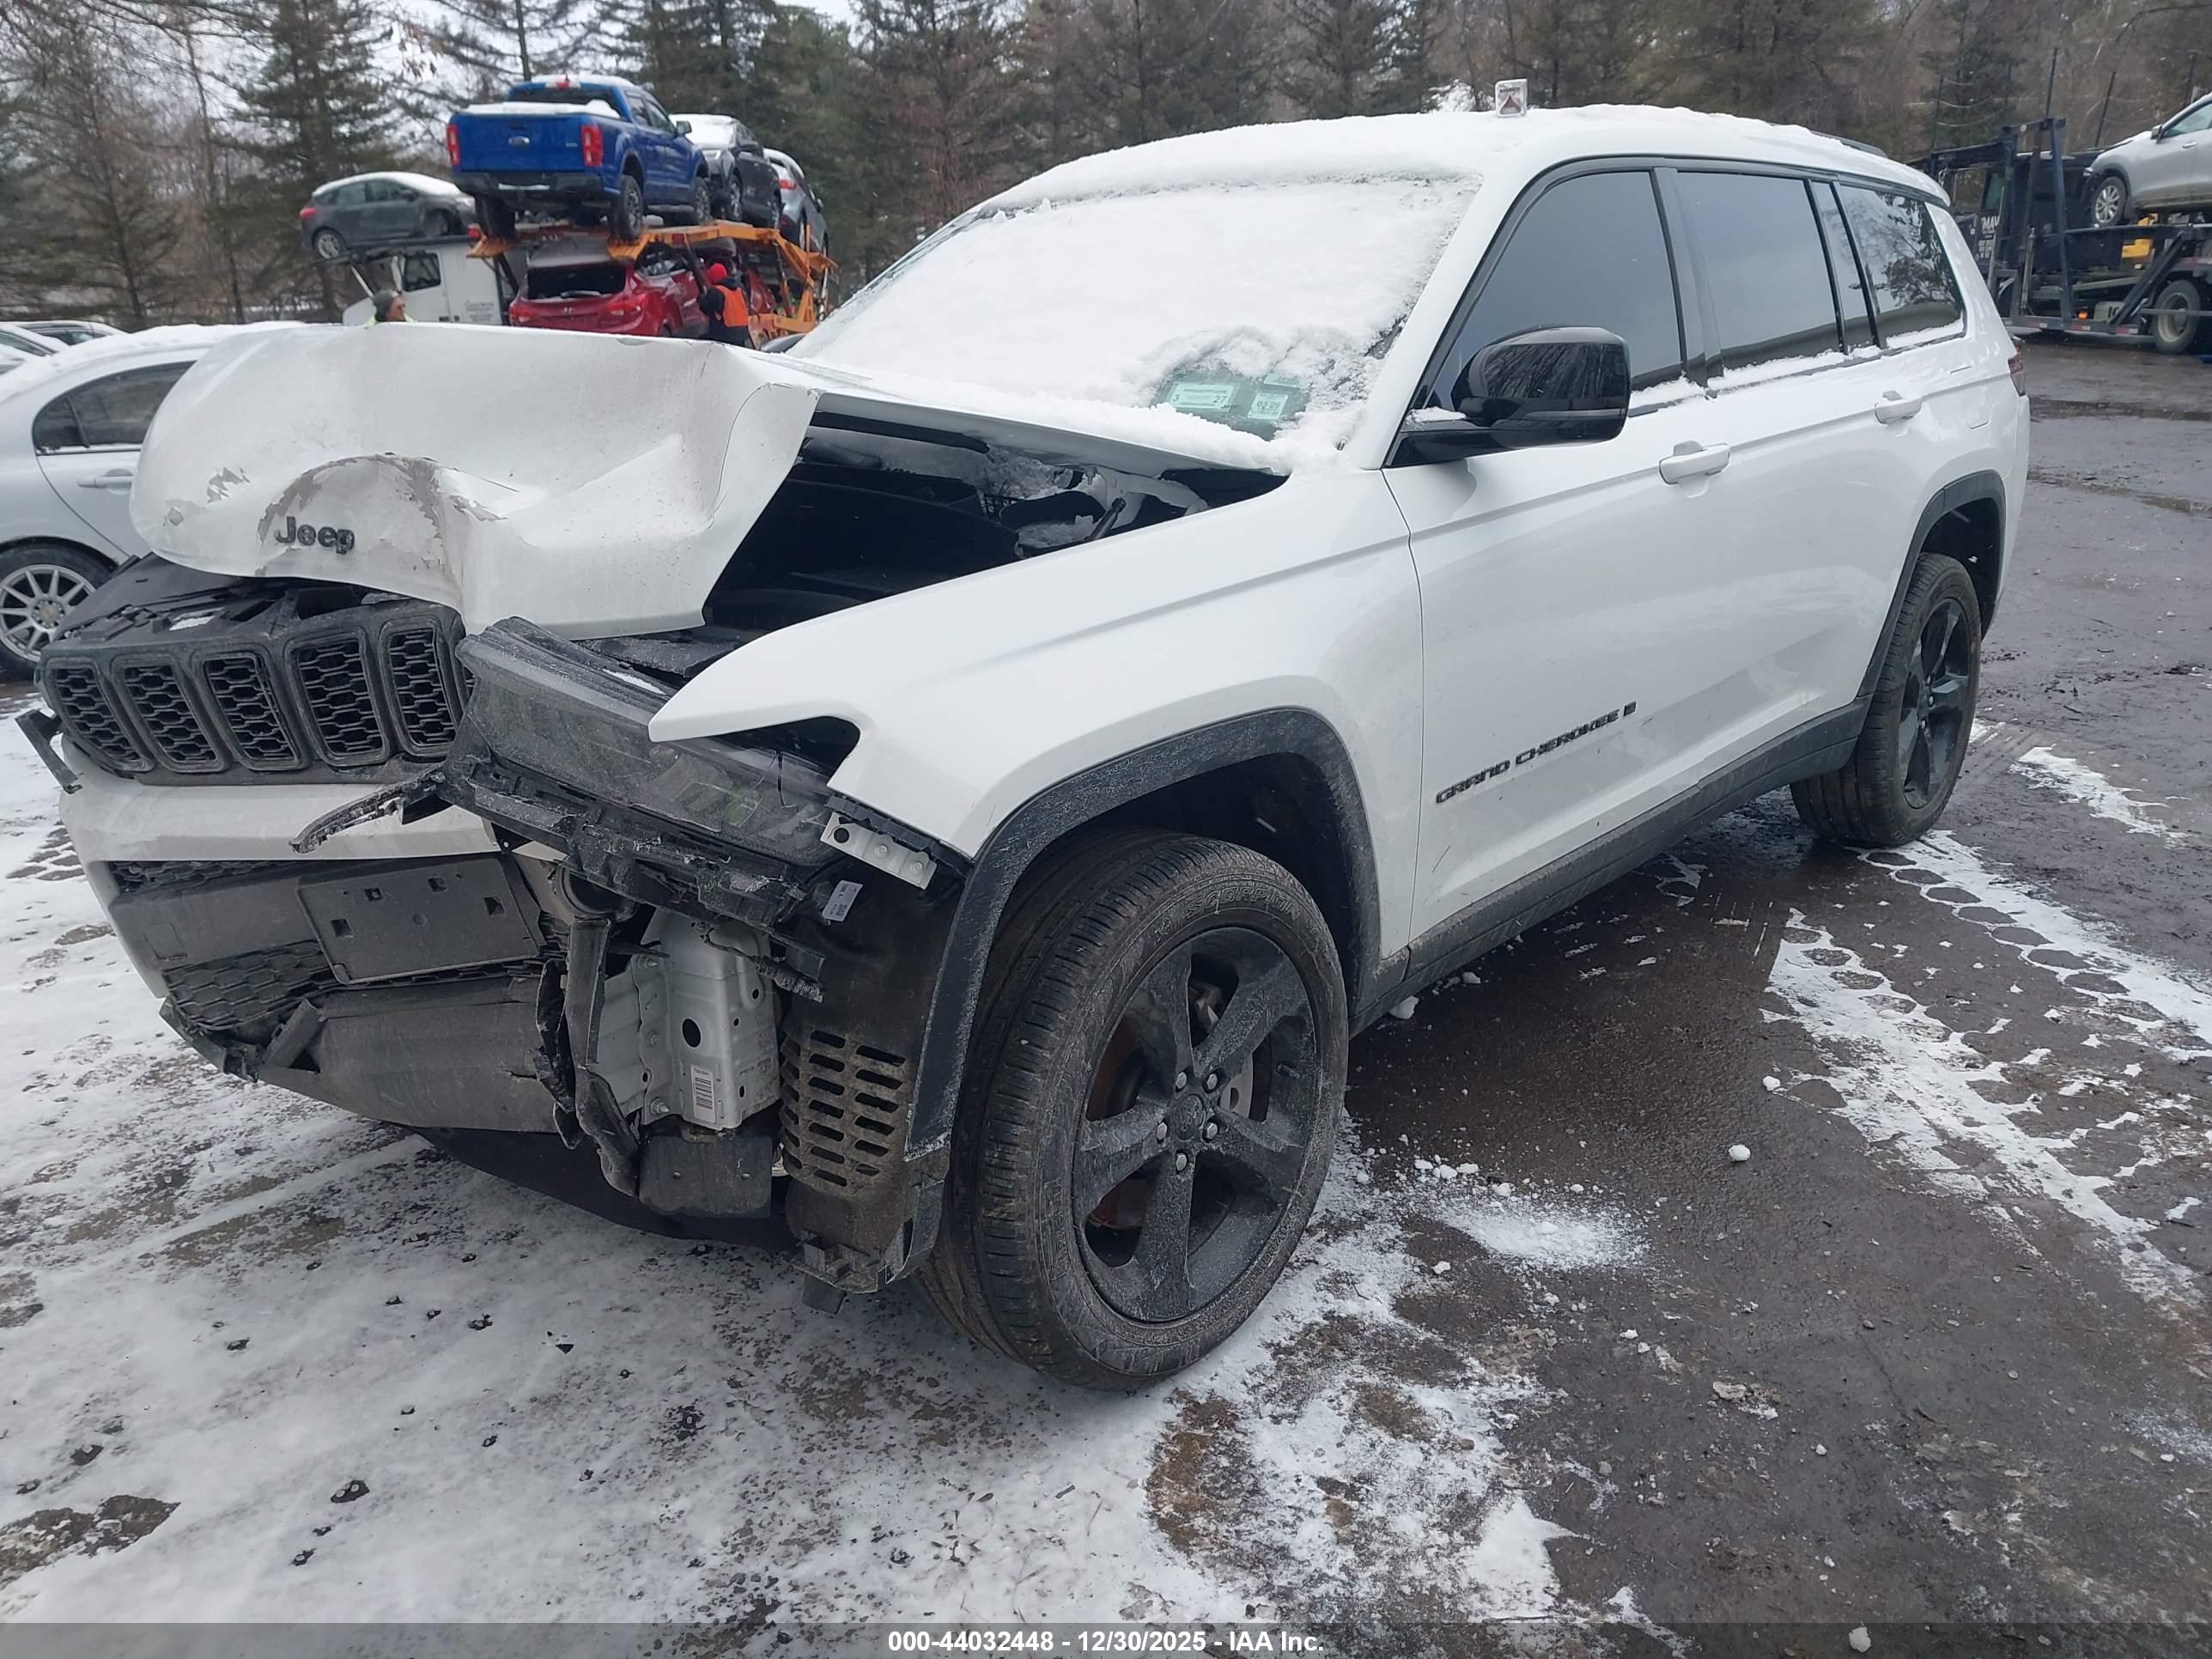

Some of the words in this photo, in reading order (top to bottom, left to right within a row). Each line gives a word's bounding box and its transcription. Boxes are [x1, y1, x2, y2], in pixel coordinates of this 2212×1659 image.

[1212, 395, 1228, 404] 27
[274, 515, 356, 556] Jeep
[1436, 759, 1511, 805] GRAND
[1515, 708, 1620, 765] CHEROKEE
[1185, 886, 1300, 921] SCORPION
